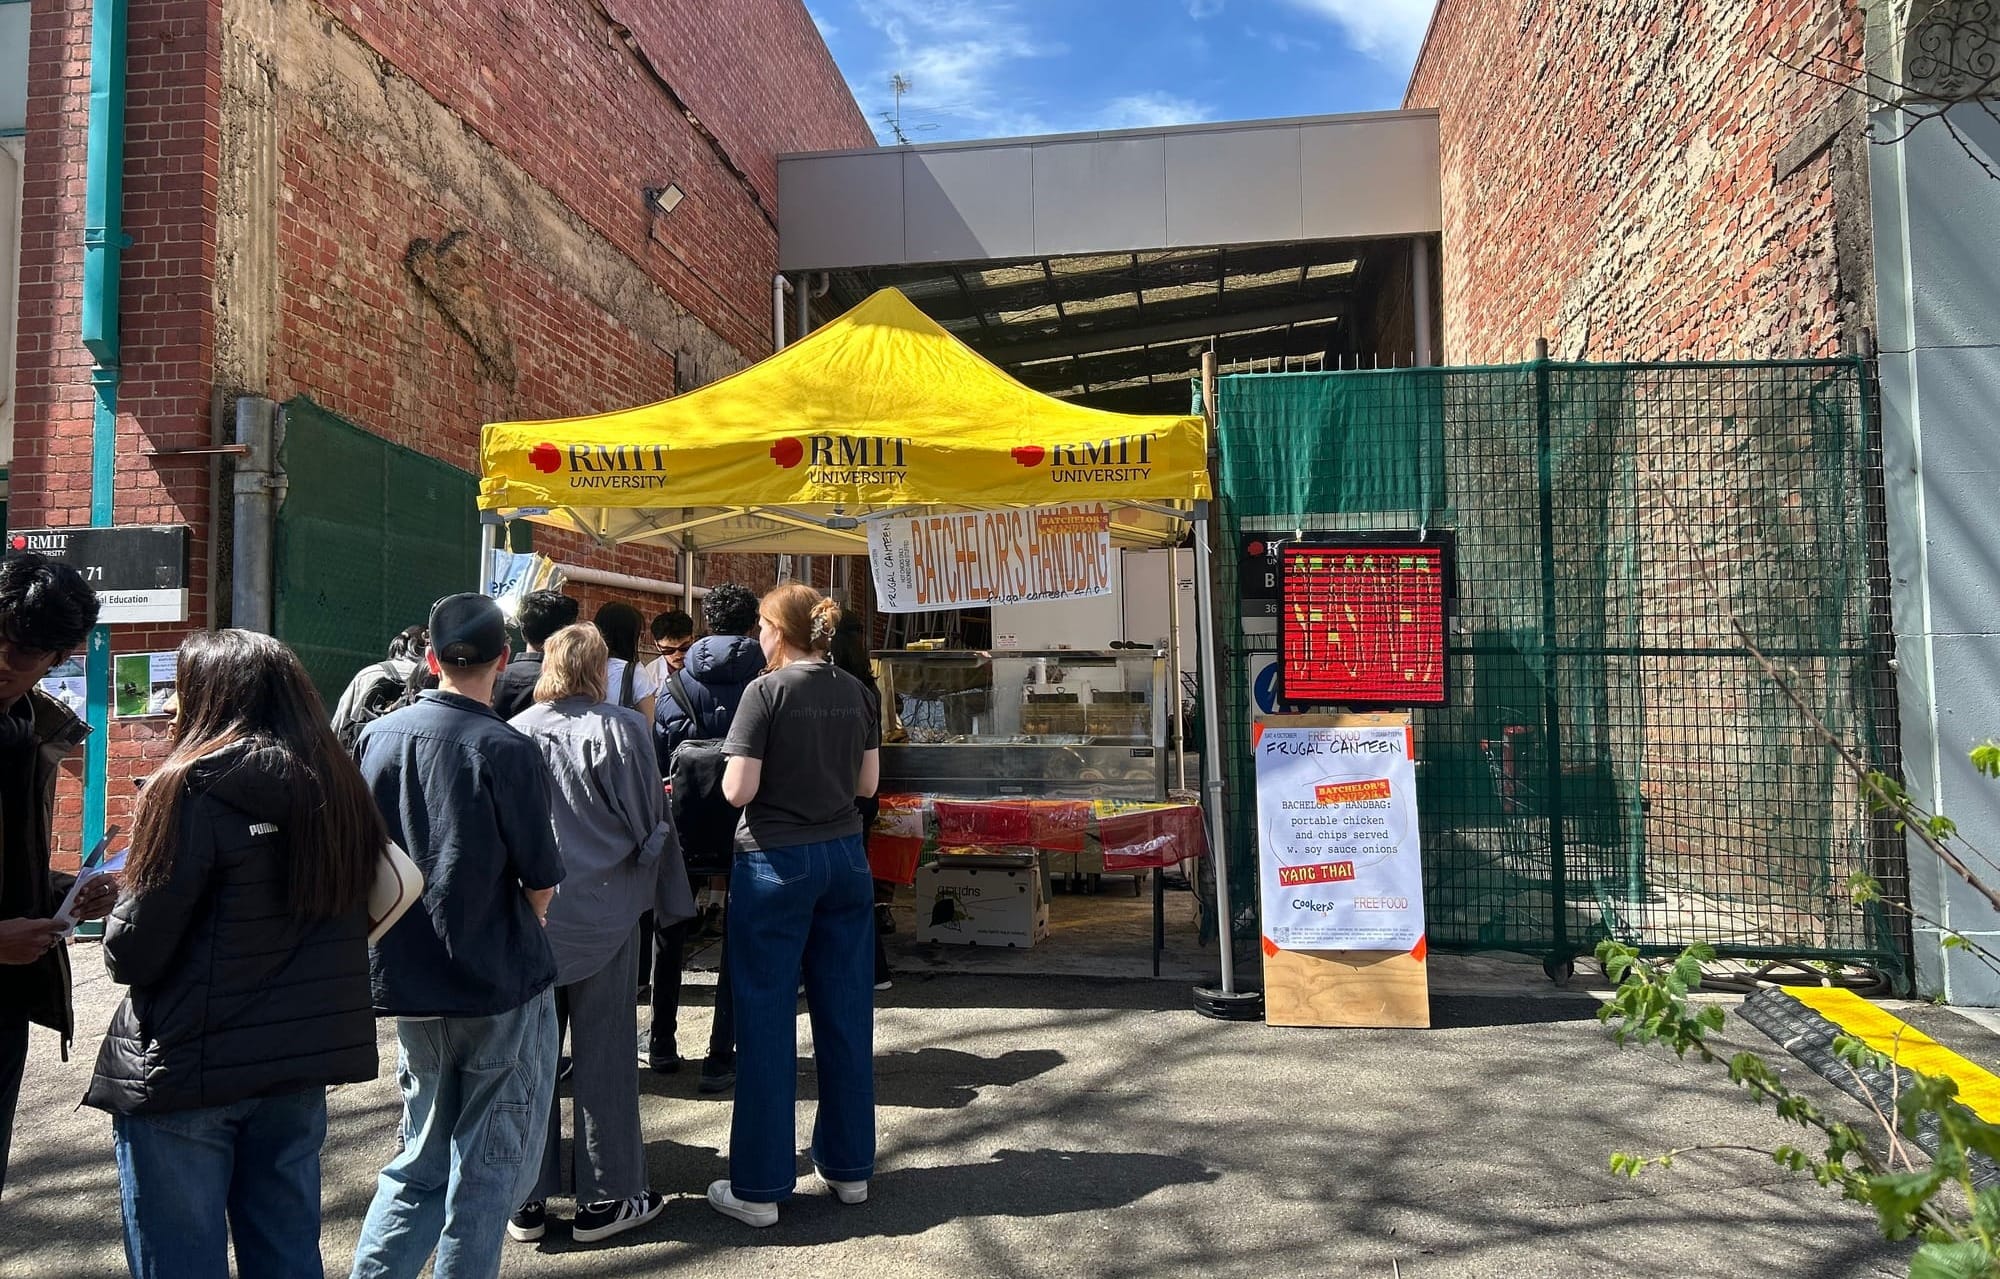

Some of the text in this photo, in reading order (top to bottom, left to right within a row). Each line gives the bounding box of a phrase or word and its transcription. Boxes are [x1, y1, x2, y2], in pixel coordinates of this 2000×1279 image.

[808, 435, 912, 467] RMIT
[1050, 432, 1157, 467] RMIT
[568, 443, 670, 472] RMIT
[809, 470, 907, 484] UNIVERSITY
[1051, 467, 1151, 482] UNIVERSITY
[570, 475, 667, 488] UNIVERSITY
[1041, 515, 1109, 525] BATCHELOR'S
[27, 534, 69, 549] RMIT
[911, 510, 1027, 605] BATCHELOR'S
[86, 566, 103, 581] 71
[109, 595, 149, 604] Education
[1308, 730, 1331, 742] FREE
[1334, 730, 1361, 742] FOOD
[1266, 739, 1402, 756] FRUGAL CANTEEN
[1319, 781, 1386, 796] BATCHELOR'S
[1345, 800, 1391, 810] HANDBAG:
[1291, 815, 1385, 827] portable chicken
[249, 823, 279, 836] PUMA
[1295, 829, 1389, 842] and chips served
[1287, 844, 1398, 856] w. soy sauce onions
[1280, 863, 1352, 883] YANG THAI
[1292, 899, 1335, 912] Cookers
[1354, 896, 1408, 909] FREE FOOD
